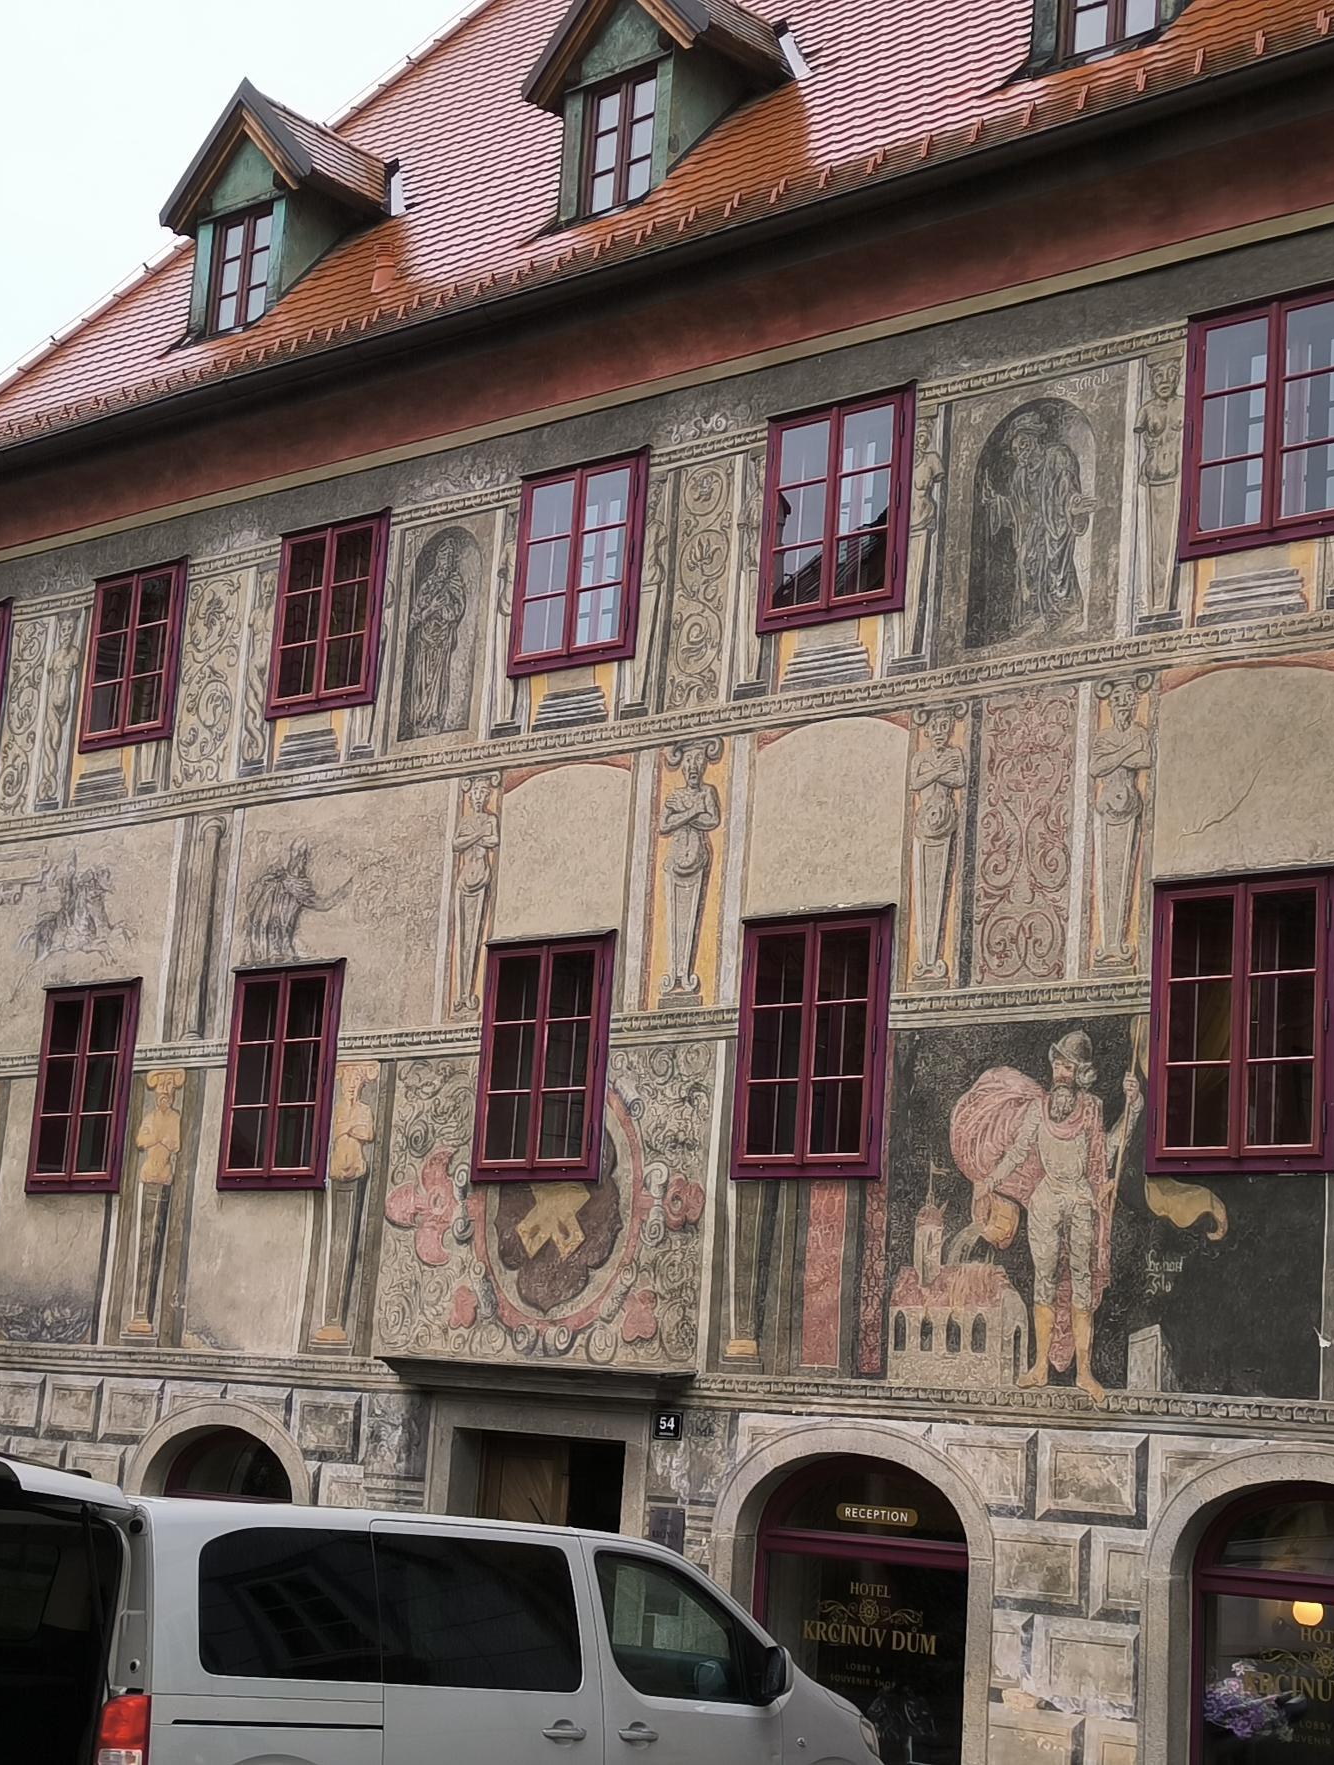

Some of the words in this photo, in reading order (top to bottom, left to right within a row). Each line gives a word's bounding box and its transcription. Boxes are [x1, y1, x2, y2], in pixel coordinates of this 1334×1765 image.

[659, 1416, 675, 1431] 54
[844, 1507, 908, 1522] RECEPTION
[850, 1581, 891, 1598] HOTEL
